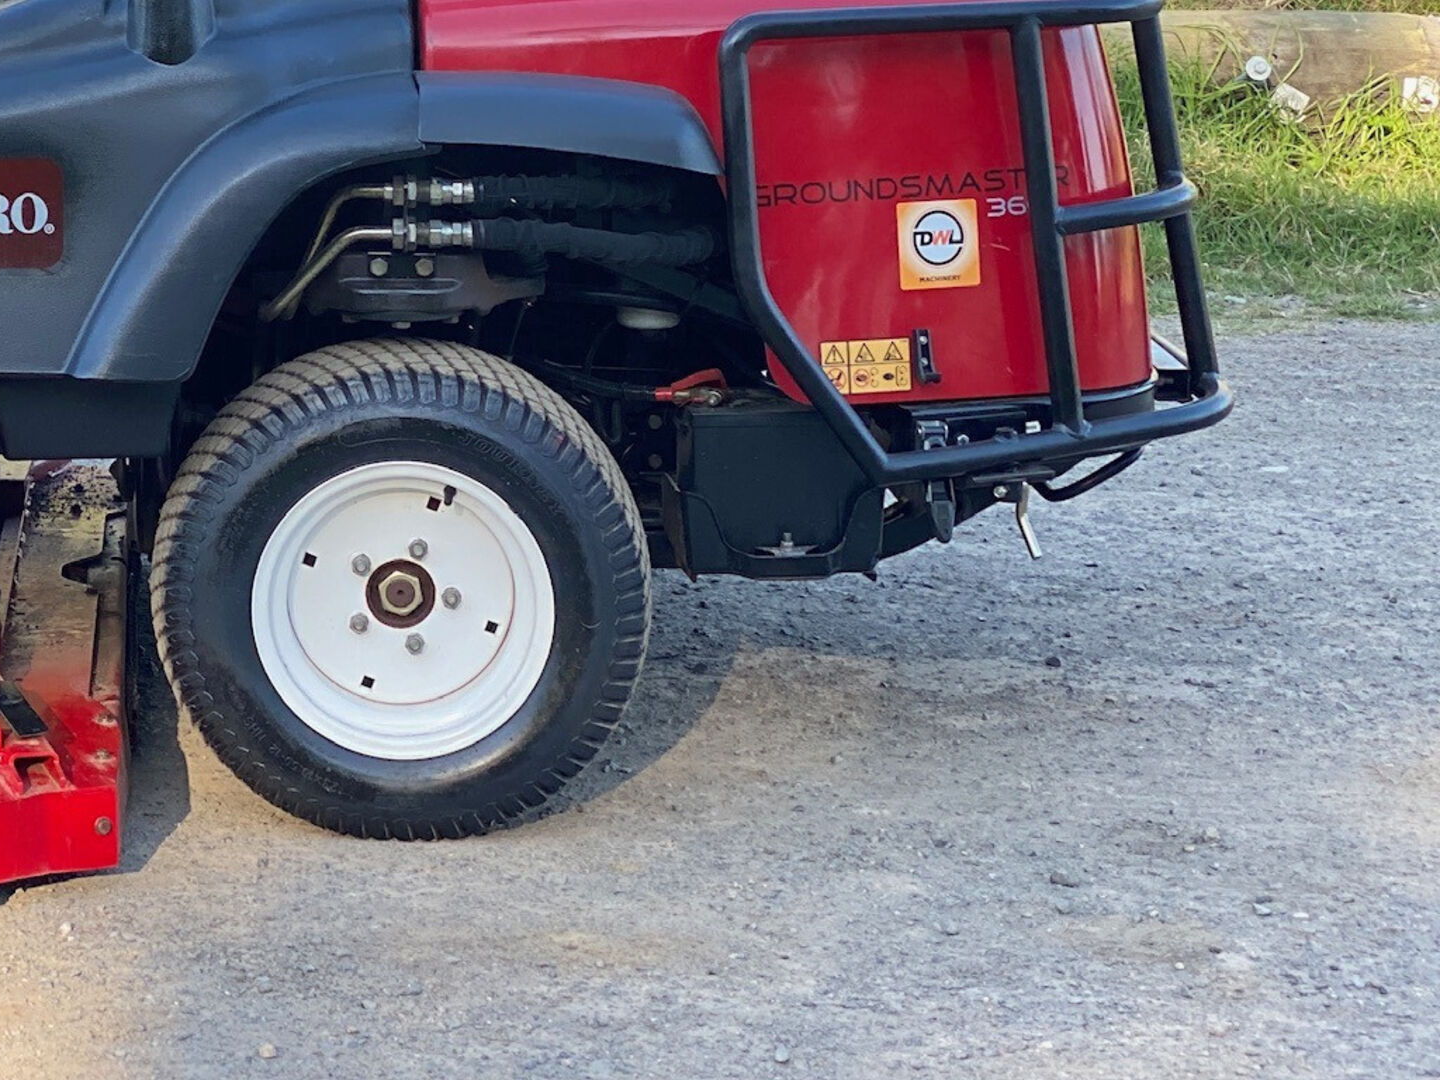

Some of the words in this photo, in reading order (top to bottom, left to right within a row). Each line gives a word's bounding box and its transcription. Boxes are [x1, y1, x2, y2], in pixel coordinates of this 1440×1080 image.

[757, 165, 1070, 207] GROUNDSMASTR
[985, 196, 1029, 218] 36
[919, 274, 961, 283] MACHINERY
